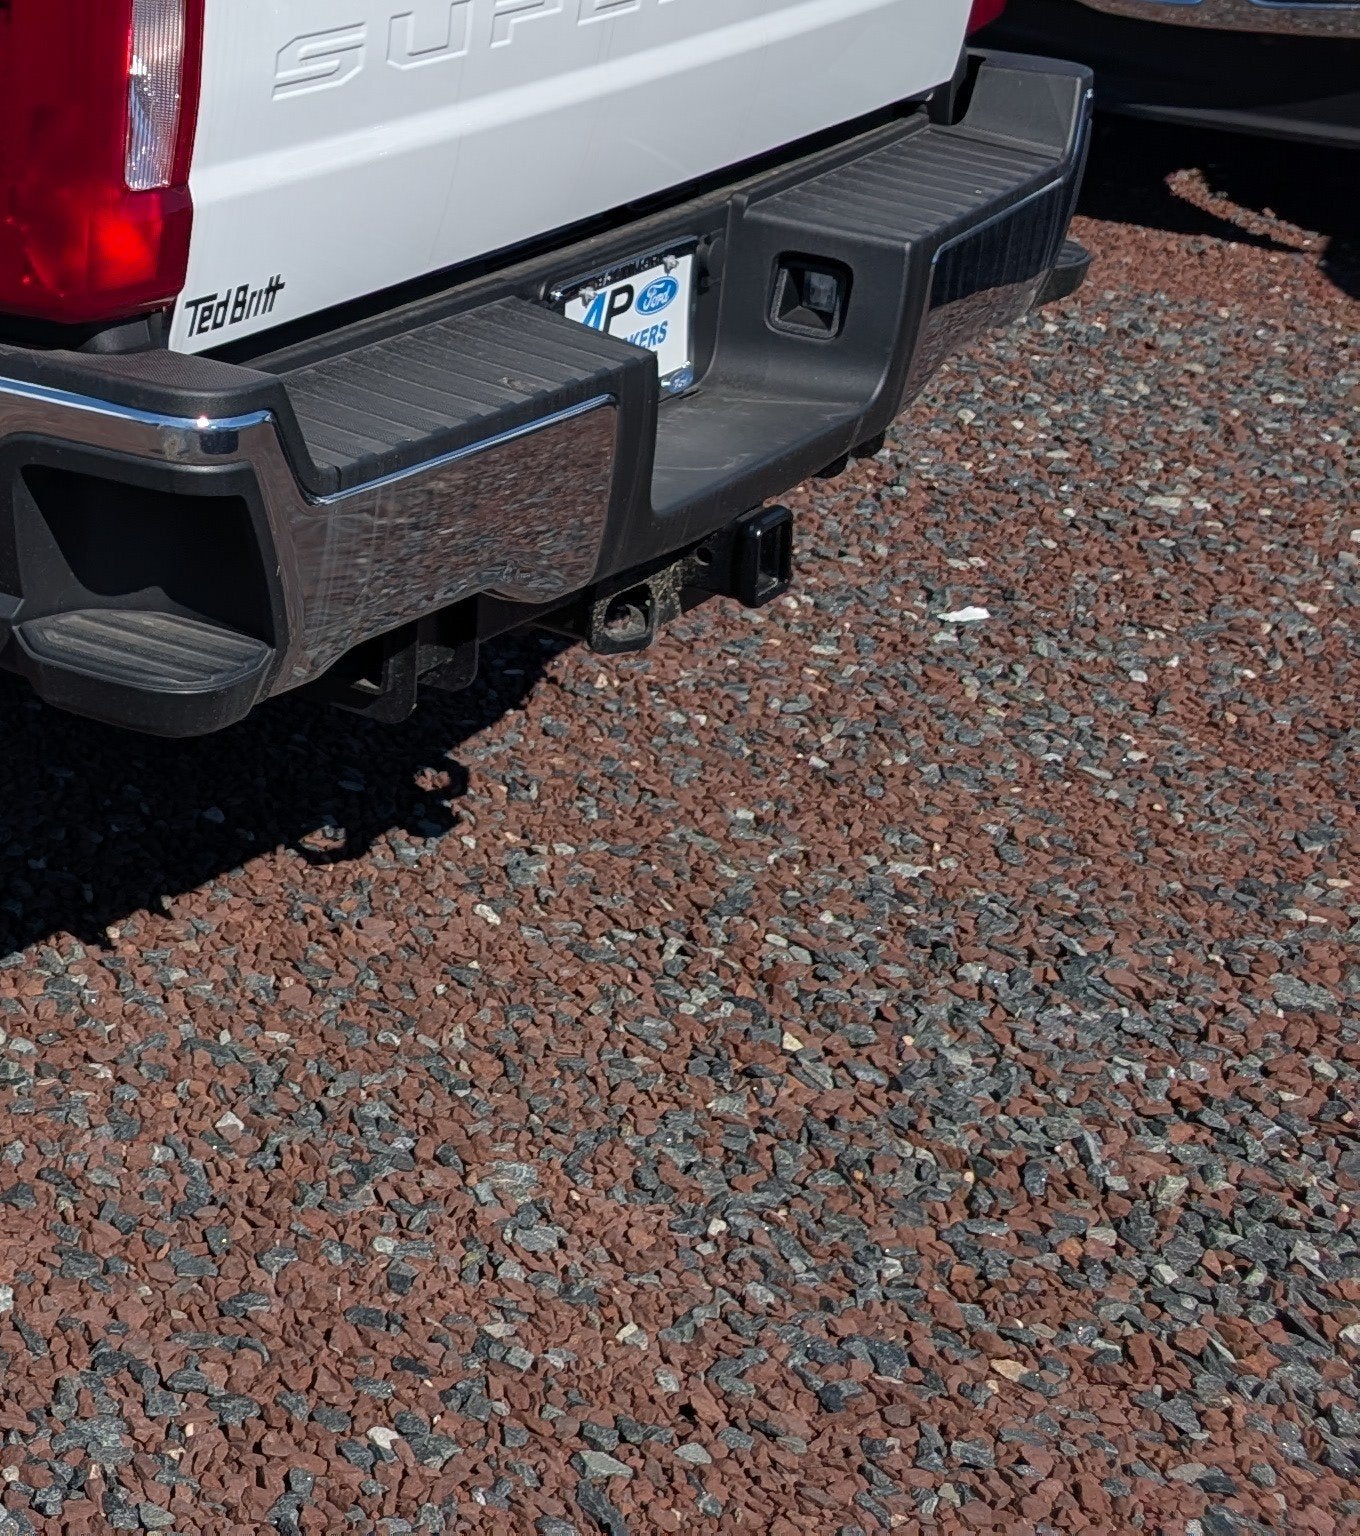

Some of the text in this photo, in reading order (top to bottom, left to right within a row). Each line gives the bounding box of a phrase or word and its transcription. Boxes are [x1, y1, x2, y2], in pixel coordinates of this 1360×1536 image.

[184, 274, 286, 338] Ted Britt
[642, 281, 673, 312] Ford
[625, 319, 669, 349] KERS
